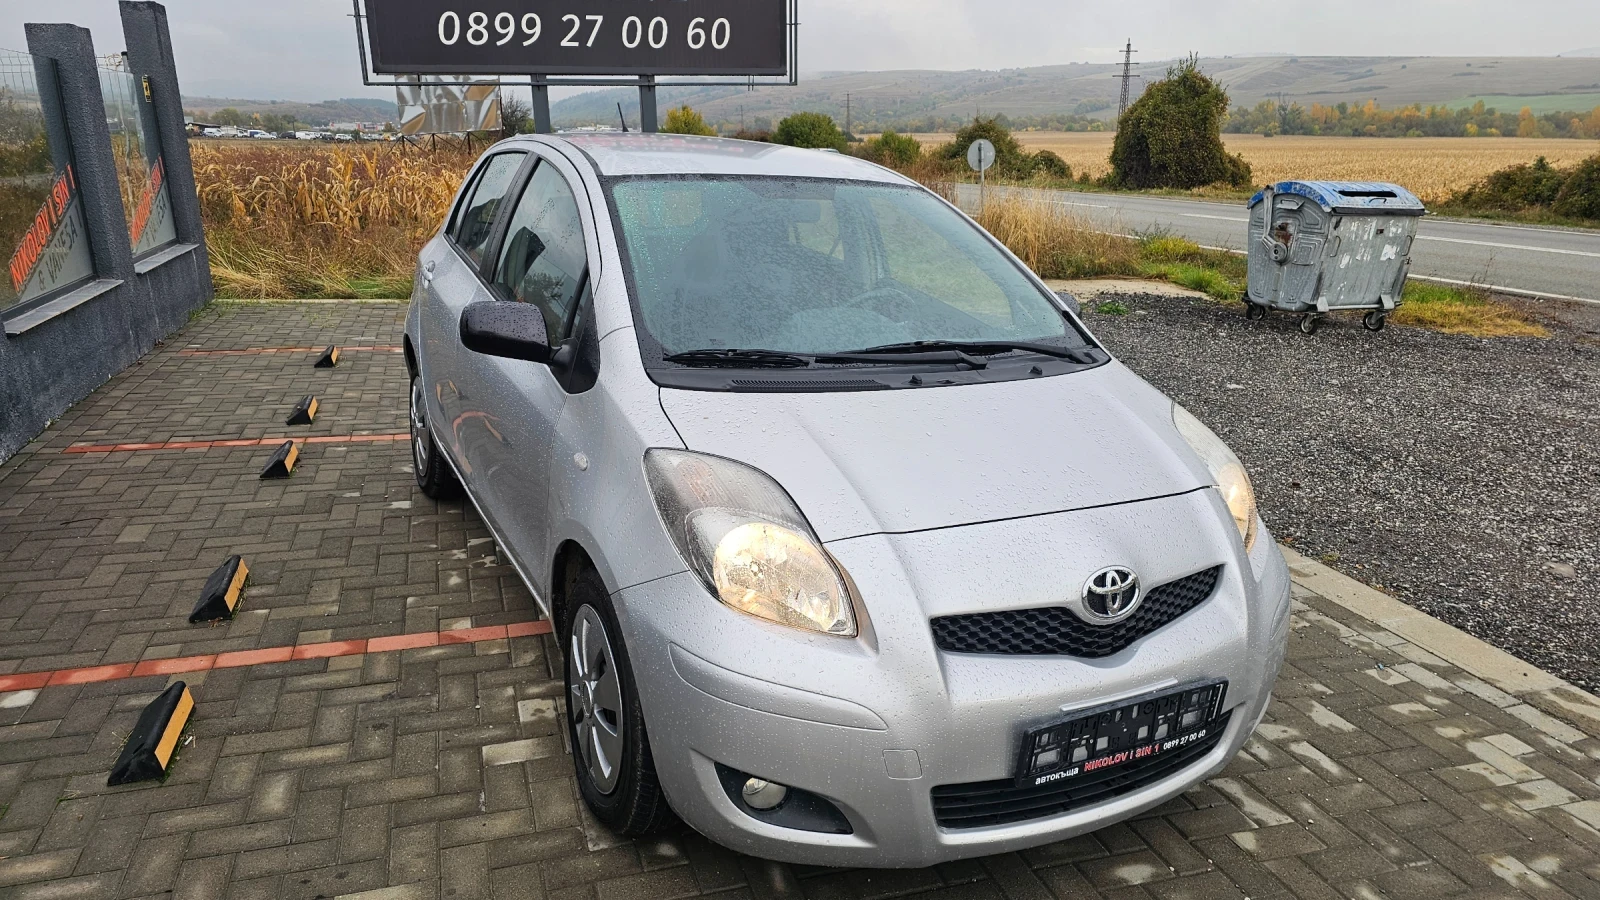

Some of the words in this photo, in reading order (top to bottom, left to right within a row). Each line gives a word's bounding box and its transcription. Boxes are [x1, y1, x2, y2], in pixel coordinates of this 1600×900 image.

[438, 11, 542, 47] 0899
[560, 14, 604, 48] 27
[621, 16, 668, 49] 00
[686, 17, 731, 50] 60
[9, 203, 52, 293] NIKOLOV
[53, 173, 70, 217] SIN
[1084, 751, 1129, 772] NIKOLOV
[1135, 745, 1152, 757] SIN
[1154, 743, 1160, 752] 1
[1163, 738, 1180, 750] 0899
[1180, 735, 1189, 745] 27
[1189, 732, 1198, 742] 00
[1197, 729, 1206, 739] 60
[1035, 767, 1079, 785] автокъща
